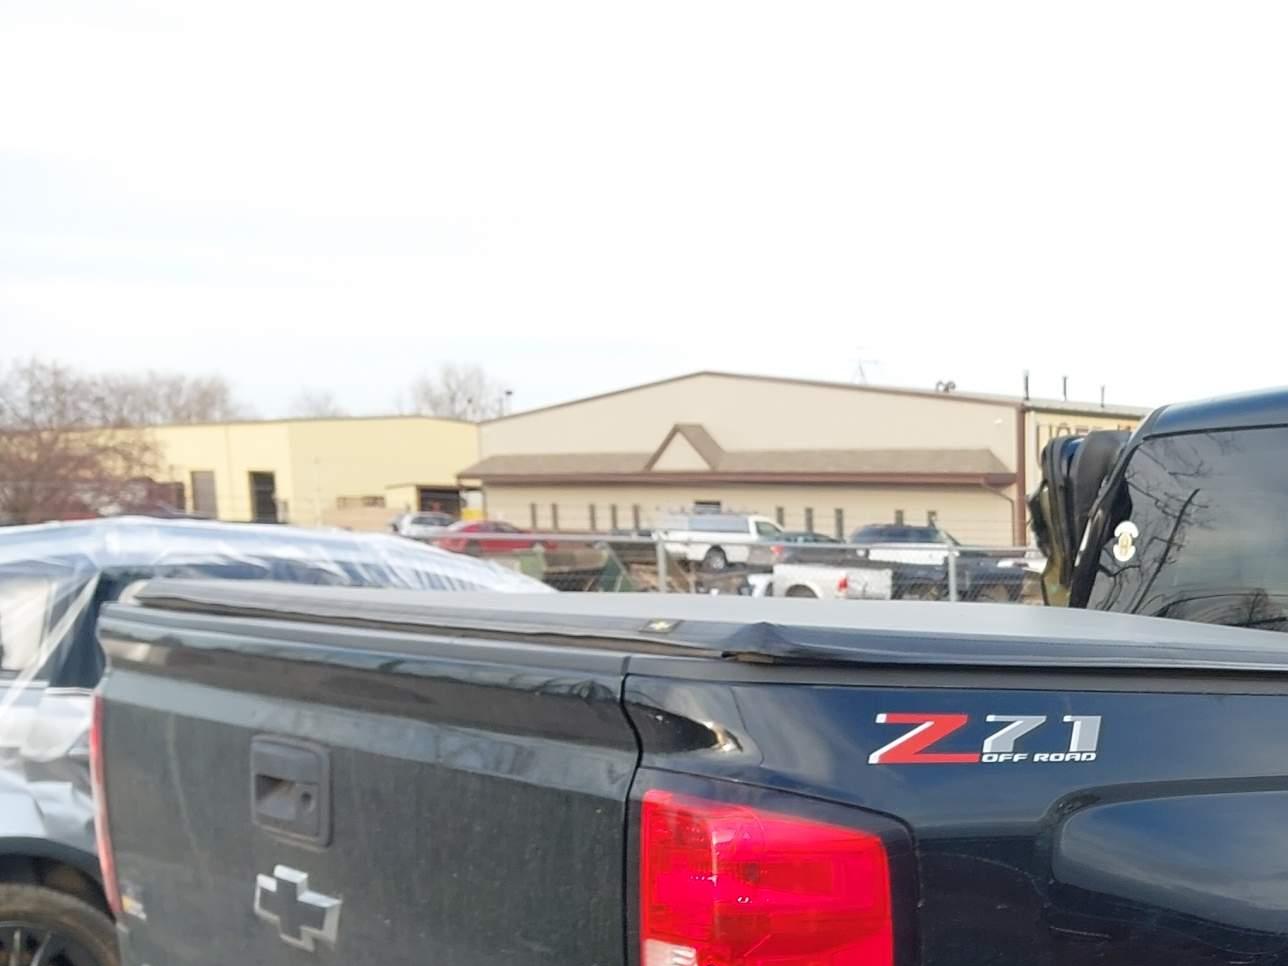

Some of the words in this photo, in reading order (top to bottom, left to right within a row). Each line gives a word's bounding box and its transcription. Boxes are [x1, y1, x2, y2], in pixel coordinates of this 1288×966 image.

[868, 713, 1102, 764] Z71
[981, 752, 1028, 763] OFF
[1032, 751, 1098, 763] ROAD
